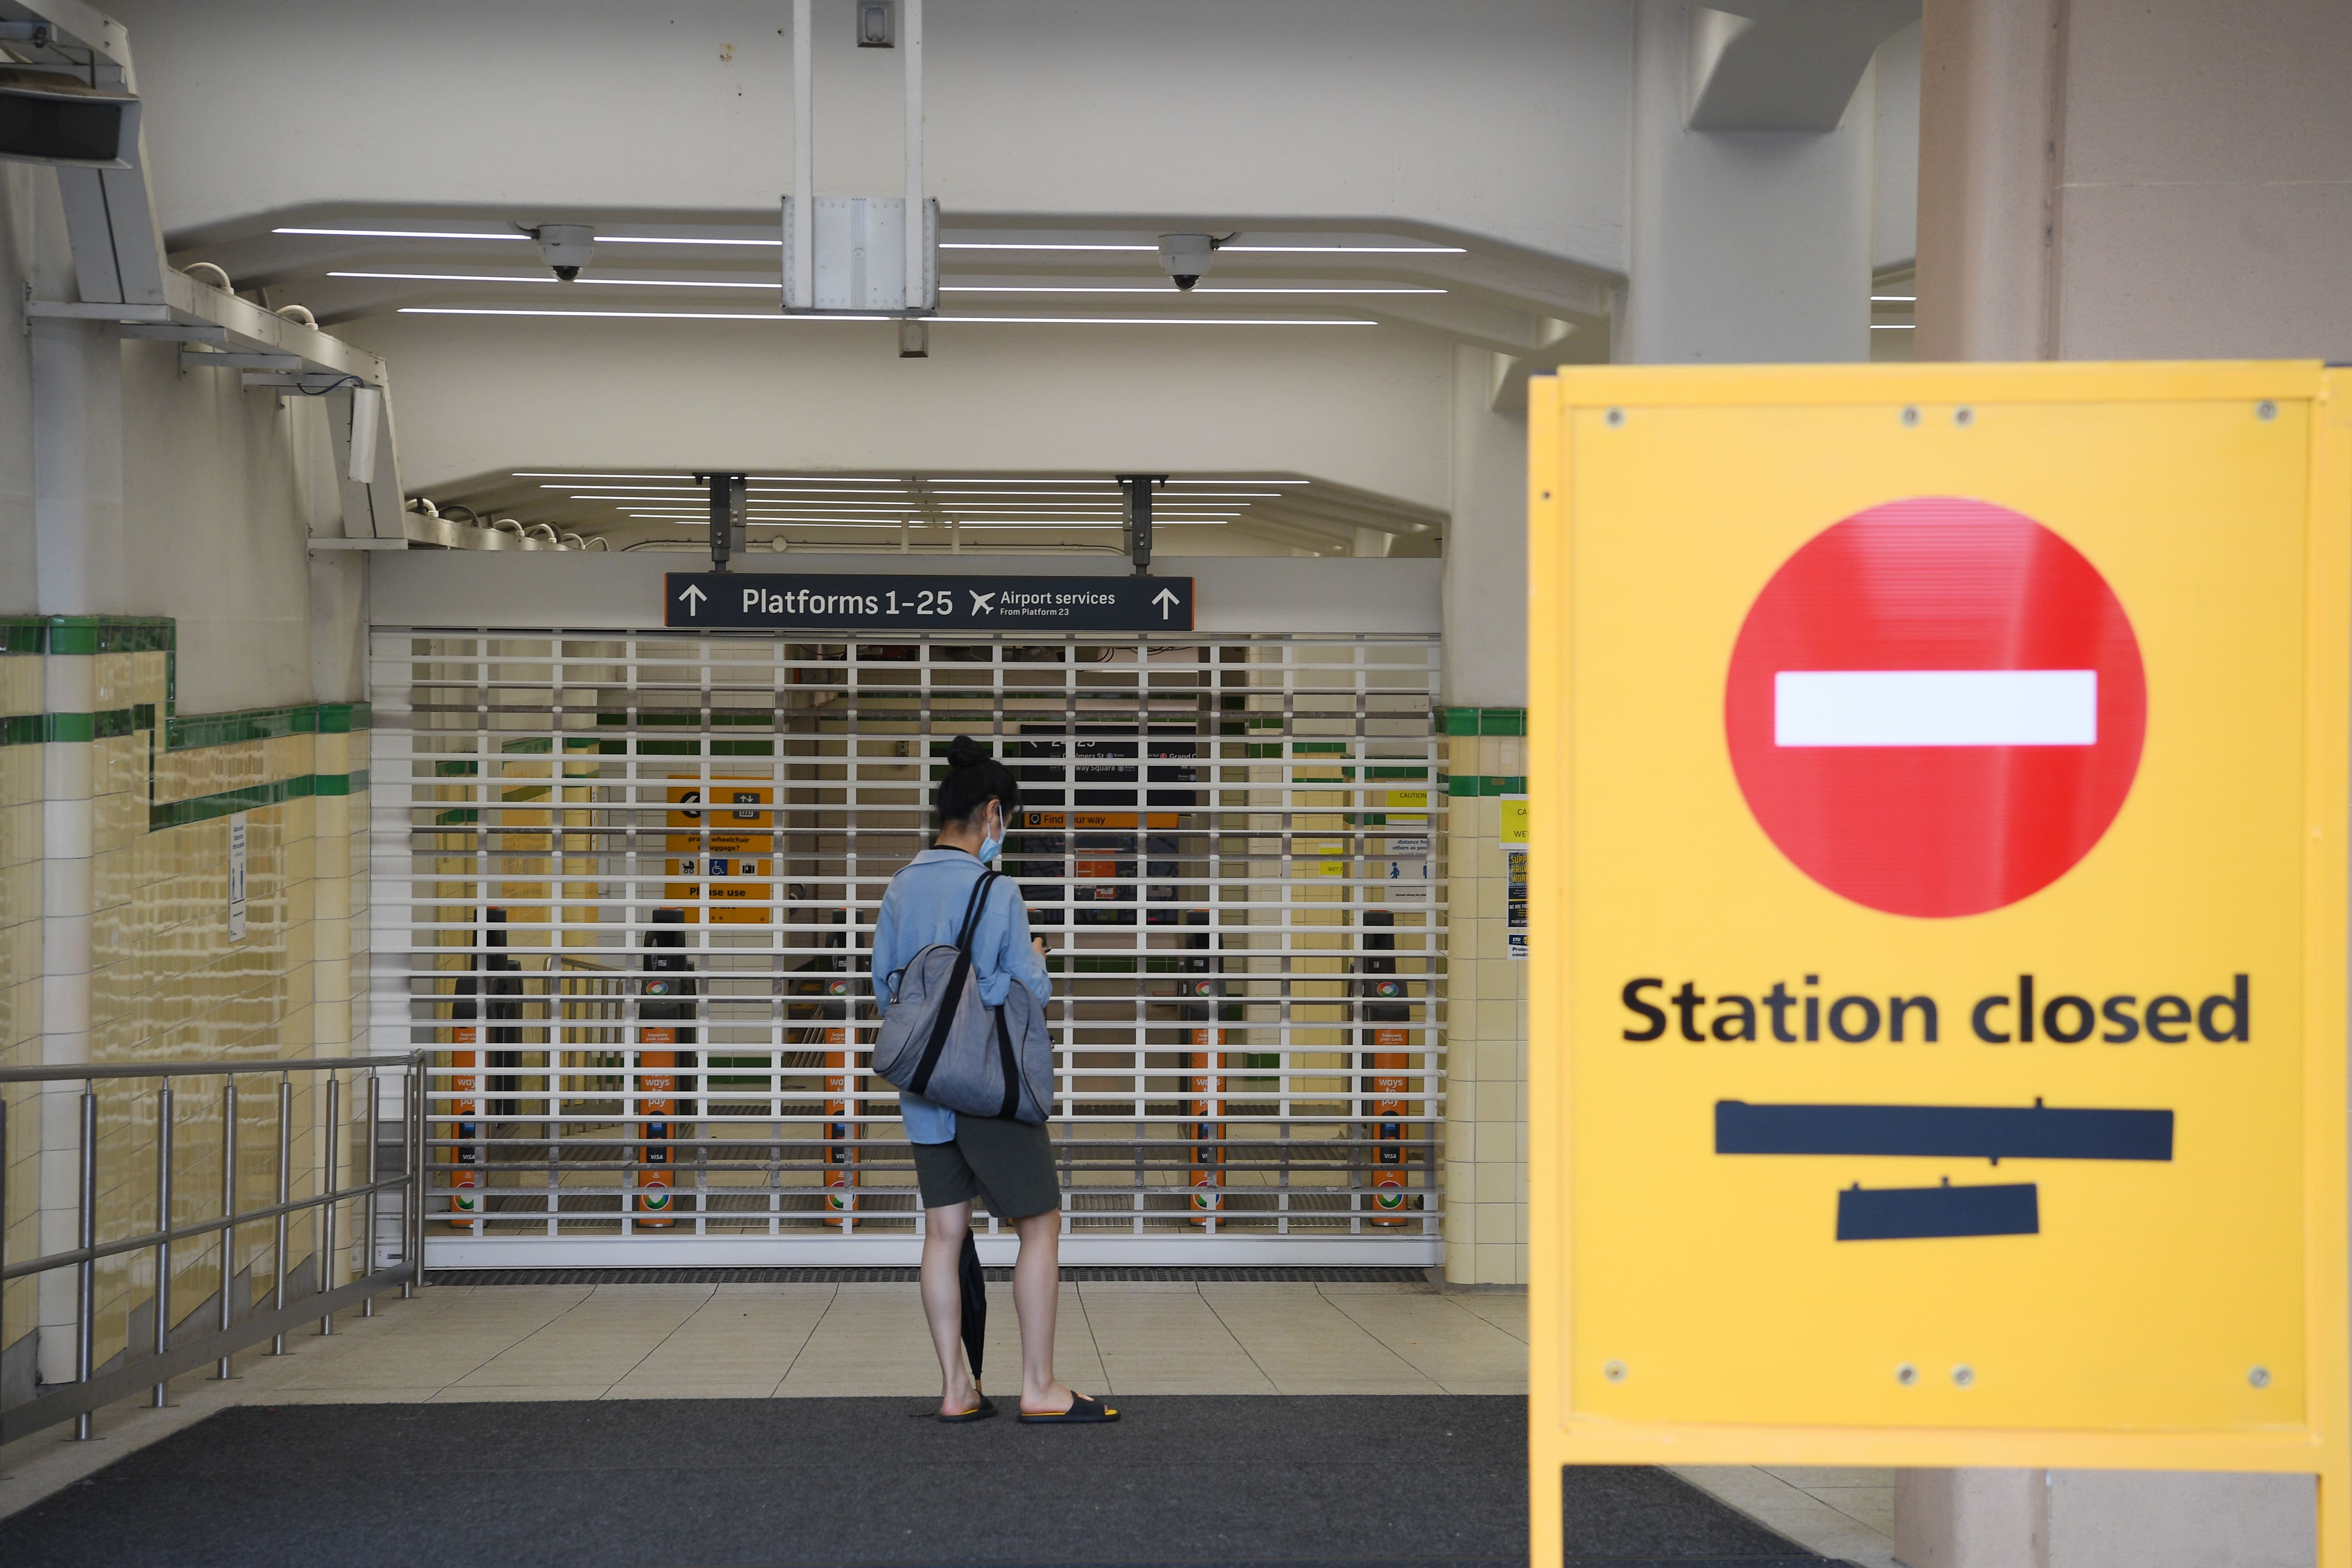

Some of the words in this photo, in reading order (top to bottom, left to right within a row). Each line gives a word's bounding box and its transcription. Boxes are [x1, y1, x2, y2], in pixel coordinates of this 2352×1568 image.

[743, 588, 879, 615] Platforms
[1000, 591, 1052, 607] Airport
[1055, 591, 1116, 604] services
[1044, 815, 1063, 823] Find
[1088, 817, 1105, 825] way
[1621, 974, 1938, 1043] Station
[1971, 973, 2250, 1044] closed
[645, 1079, 670, 1089] ways
[1379, 1079, 1403, 1089] ways
[648, 1099, 666, 1107] pay
